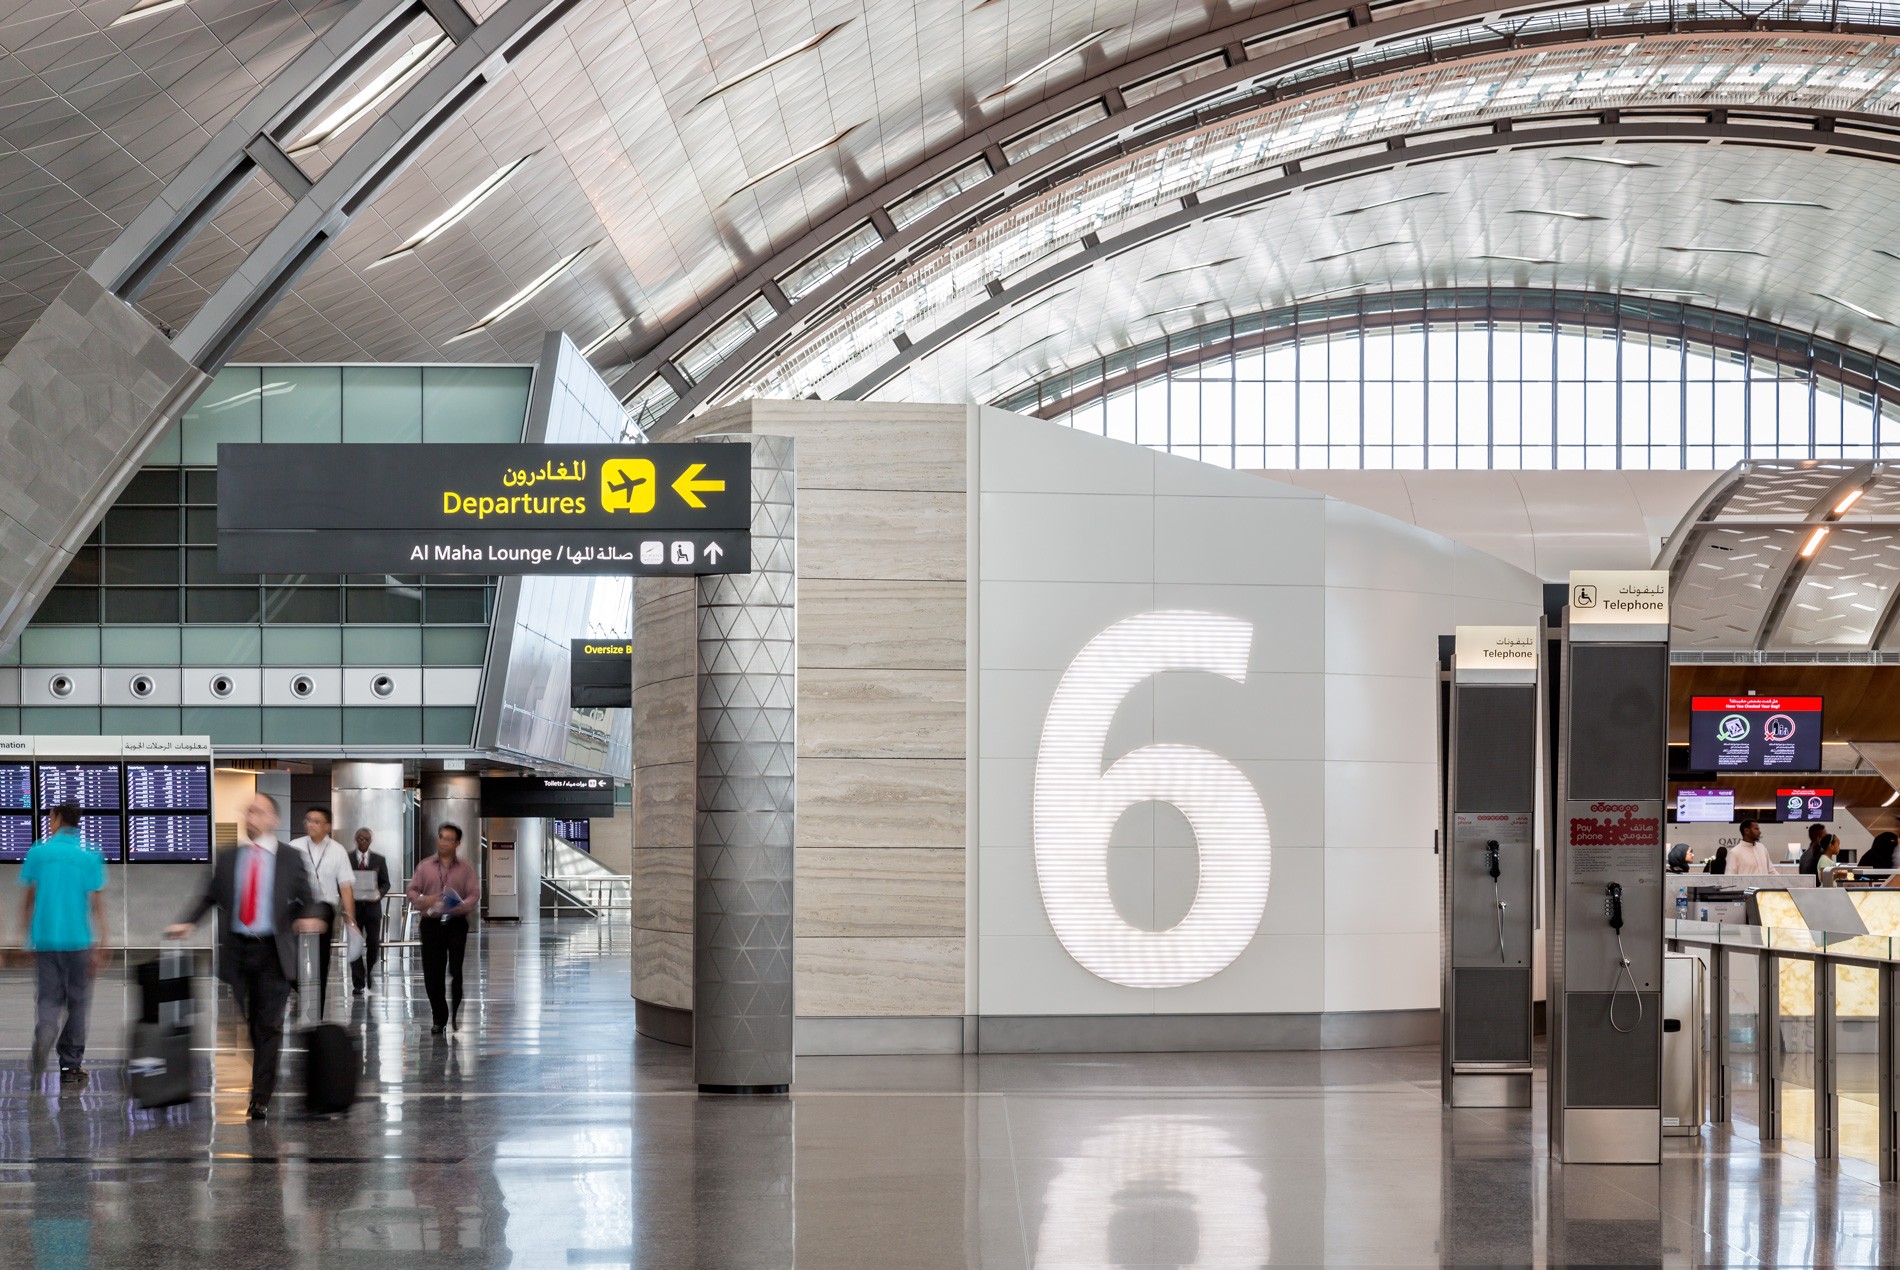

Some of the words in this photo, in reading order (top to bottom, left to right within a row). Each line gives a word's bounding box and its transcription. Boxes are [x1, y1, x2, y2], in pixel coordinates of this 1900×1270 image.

[503, 460, 586, 486] المغادرون
[443, 492, 586, 519] Departures
[410, 544, 428, 561] Al
[433, 544, 482, 561] Maha
[488, 545, 552, 564] Lounge
[566, 546, 594, 564] المها
[597, 546, 633, 561] صالة
[1620, 585, 1664, 596] تليفونات
[1603, 599, 1664, 611] Telephone
[584, 644, 624, 654] Oversize
[1483, 649, 1532, 659] Telephone
[175, 742, 208, 751] معلومات
[1033, 609, 1271, 988] 6
[1576, 824, 1592, 832] Pay
[1576, 833, 1603, 841] phone
